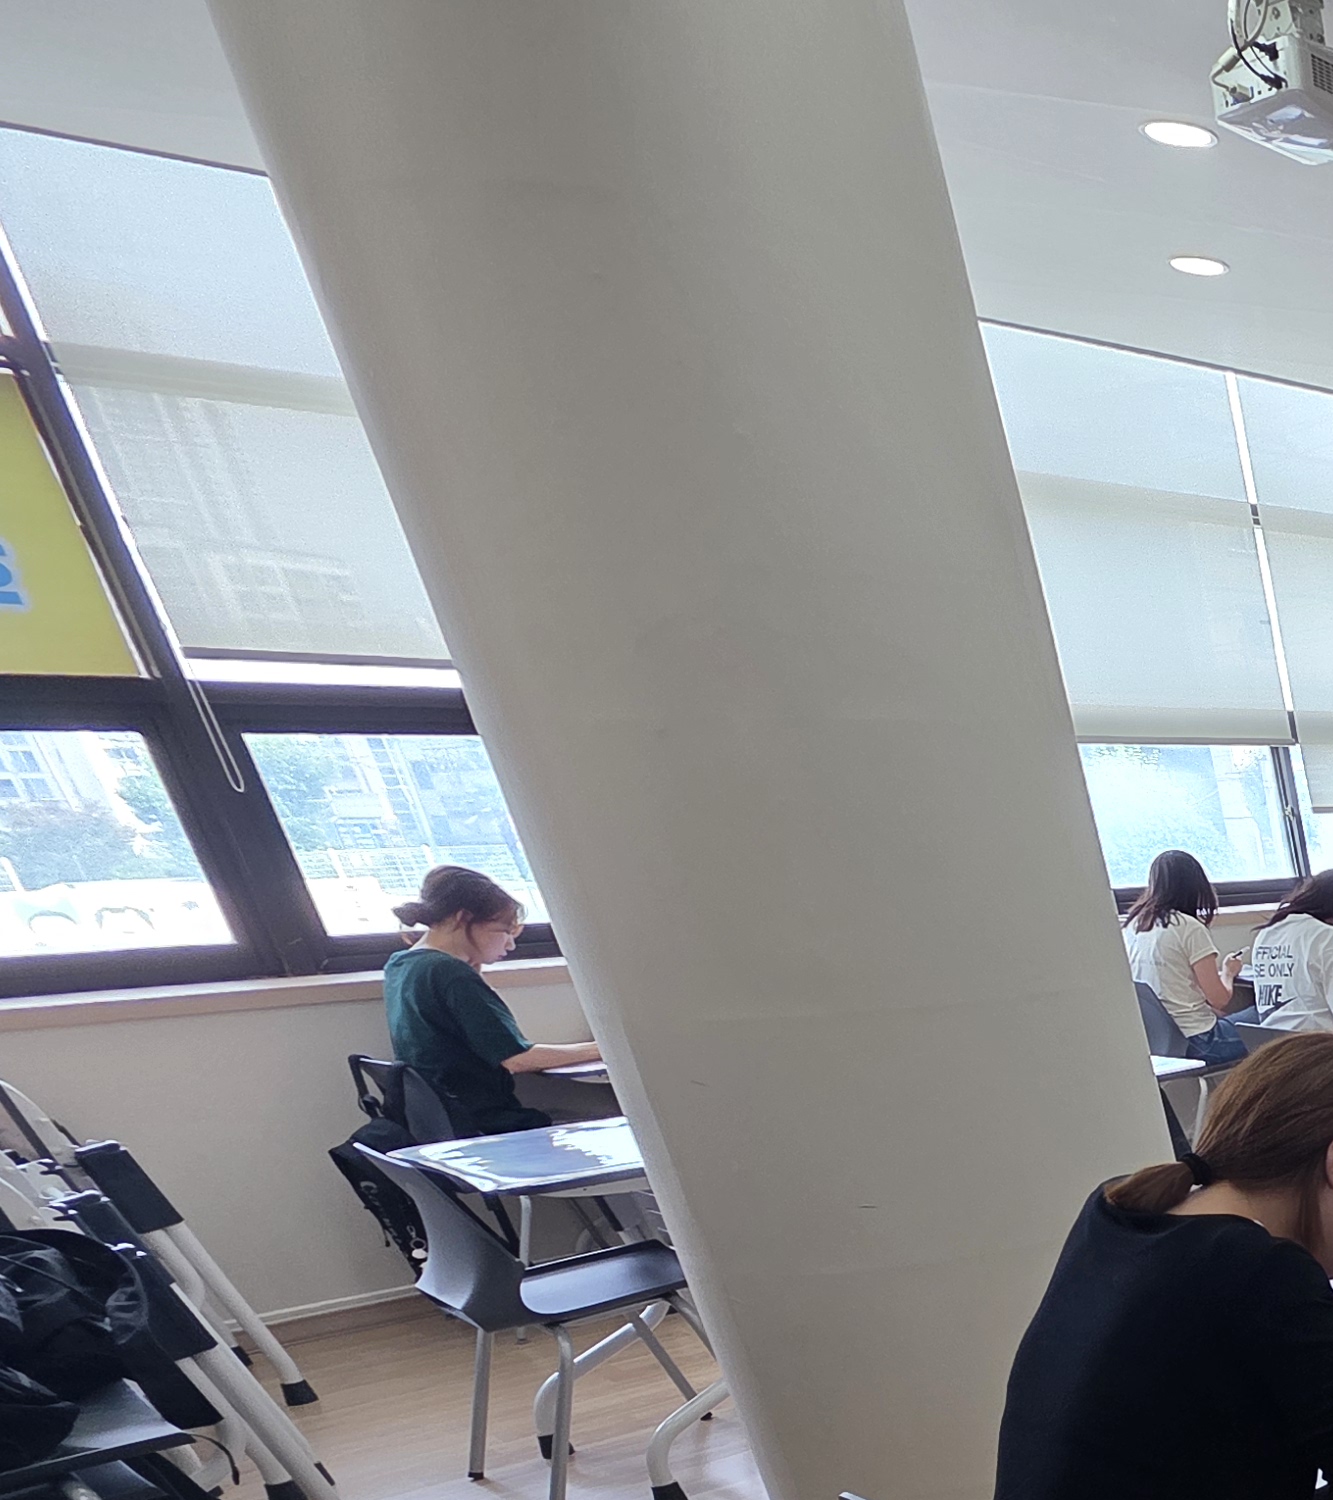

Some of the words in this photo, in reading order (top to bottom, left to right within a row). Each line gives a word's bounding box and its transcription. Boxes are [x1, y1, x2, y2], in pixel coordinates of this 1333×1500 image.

[1255, 945, 1293, 960] FFICIAL
[1254, 963, 1265, 977] SE
[1268, 962, 1295, 978] ONLY
